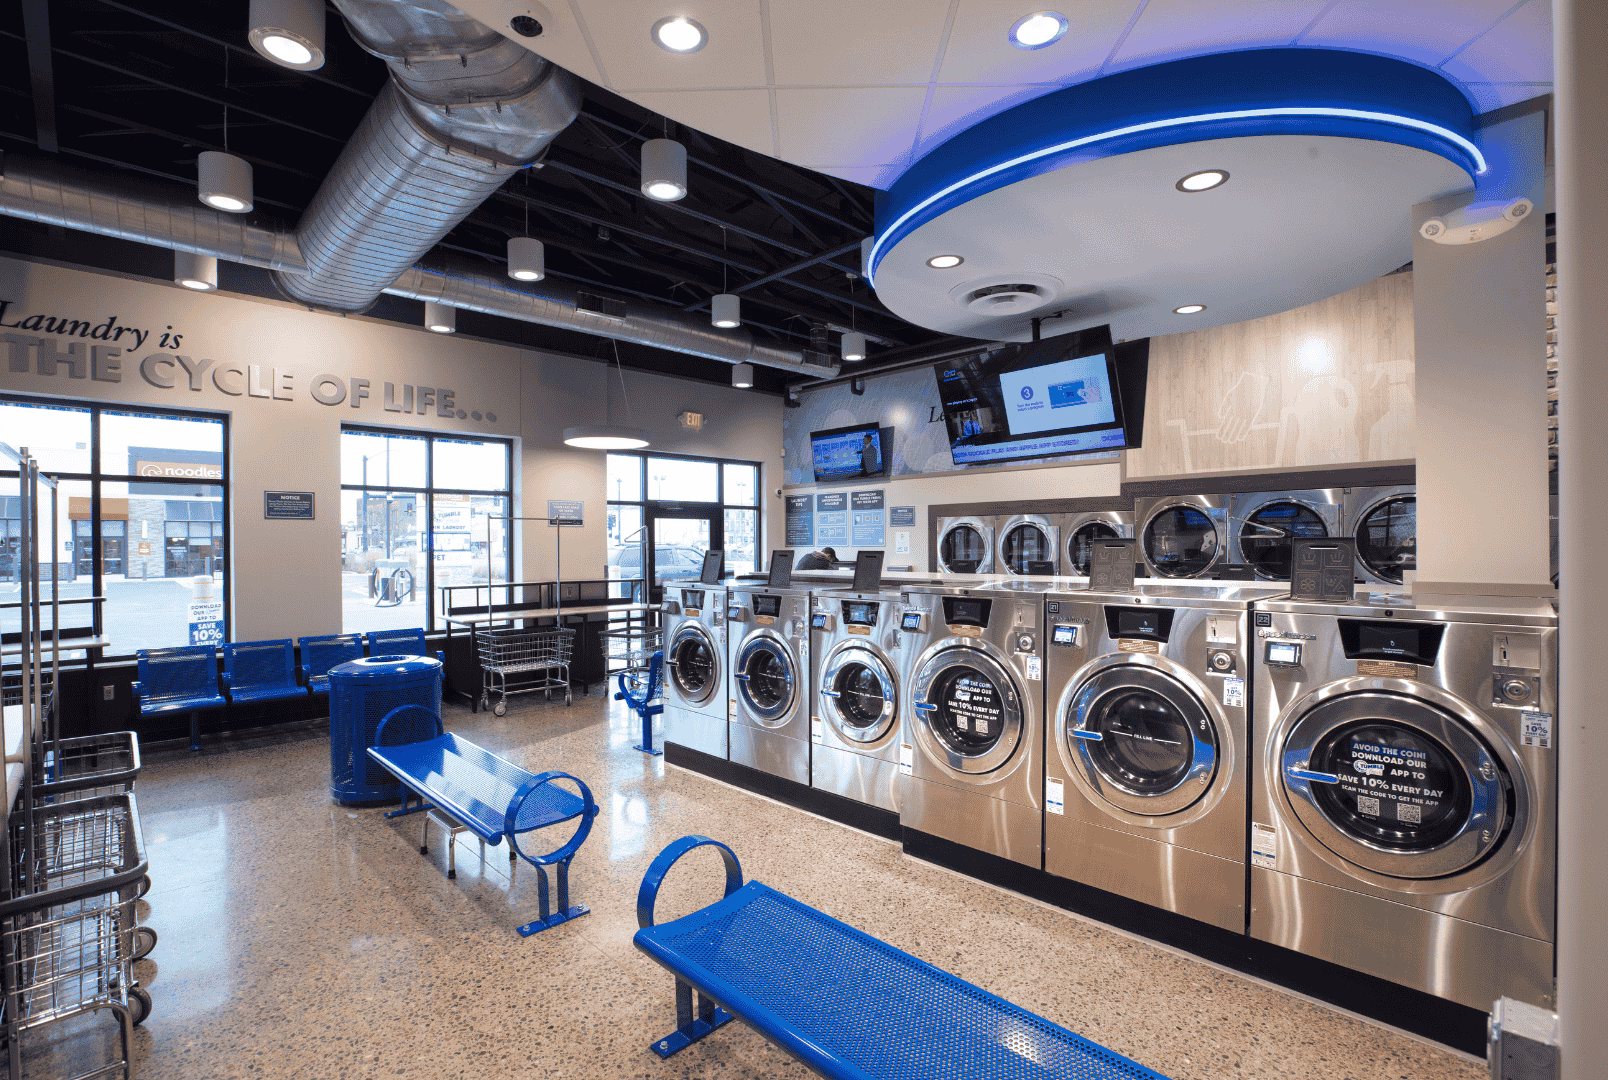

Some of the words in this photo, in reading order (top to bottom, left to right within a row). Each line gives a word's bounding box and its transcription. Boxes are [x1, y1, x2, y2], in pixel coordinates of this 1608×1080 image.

[0, 301, 148, 352] Laundry
[159, 325, 184, 350] is
[0, 332, 122, 384] THE
[139, 352, 293, 402] CYCLE
[310, 374, 370, 408] OF
[384, 381, 498, 423] LIFE...
[687, 412, 701, 426] EXIT
[165, 466, 223, 478] noodles
[192, 628, 223, 642] 10%
[955, 684, 981, 693] DOWNLOAD
[1226, 688, 1242, 696] 10%
[958, 701, 973, 711] 10%
[973, 706, 988, 714] EVERY
[1526, 725, 1548, 734] 10%
[1353, 743, 1380, 753] AVOID
[1382, 747, 1398, 756] THE
[1400, 750, 1427, 760] COIN!
[1351, 751, 1404, 765] DOWNLOAD
[1406, 759, 1427, 769] OUR
[1390, 768, 1410, 777] APP
[1412, 772, 1426, 780] TO
[1337, 773, 1359, 784] SAVE
[1361, 776, 1389, 790] 10%
[1391, 783, 1422, 795] EVERY
[1423, 788, 1444, 798] DAY
[1341, 784, 1357, 793] SCAN
[1357, 787, 1369, 795] THE
[1370, 790, 1387, 798] CODE
